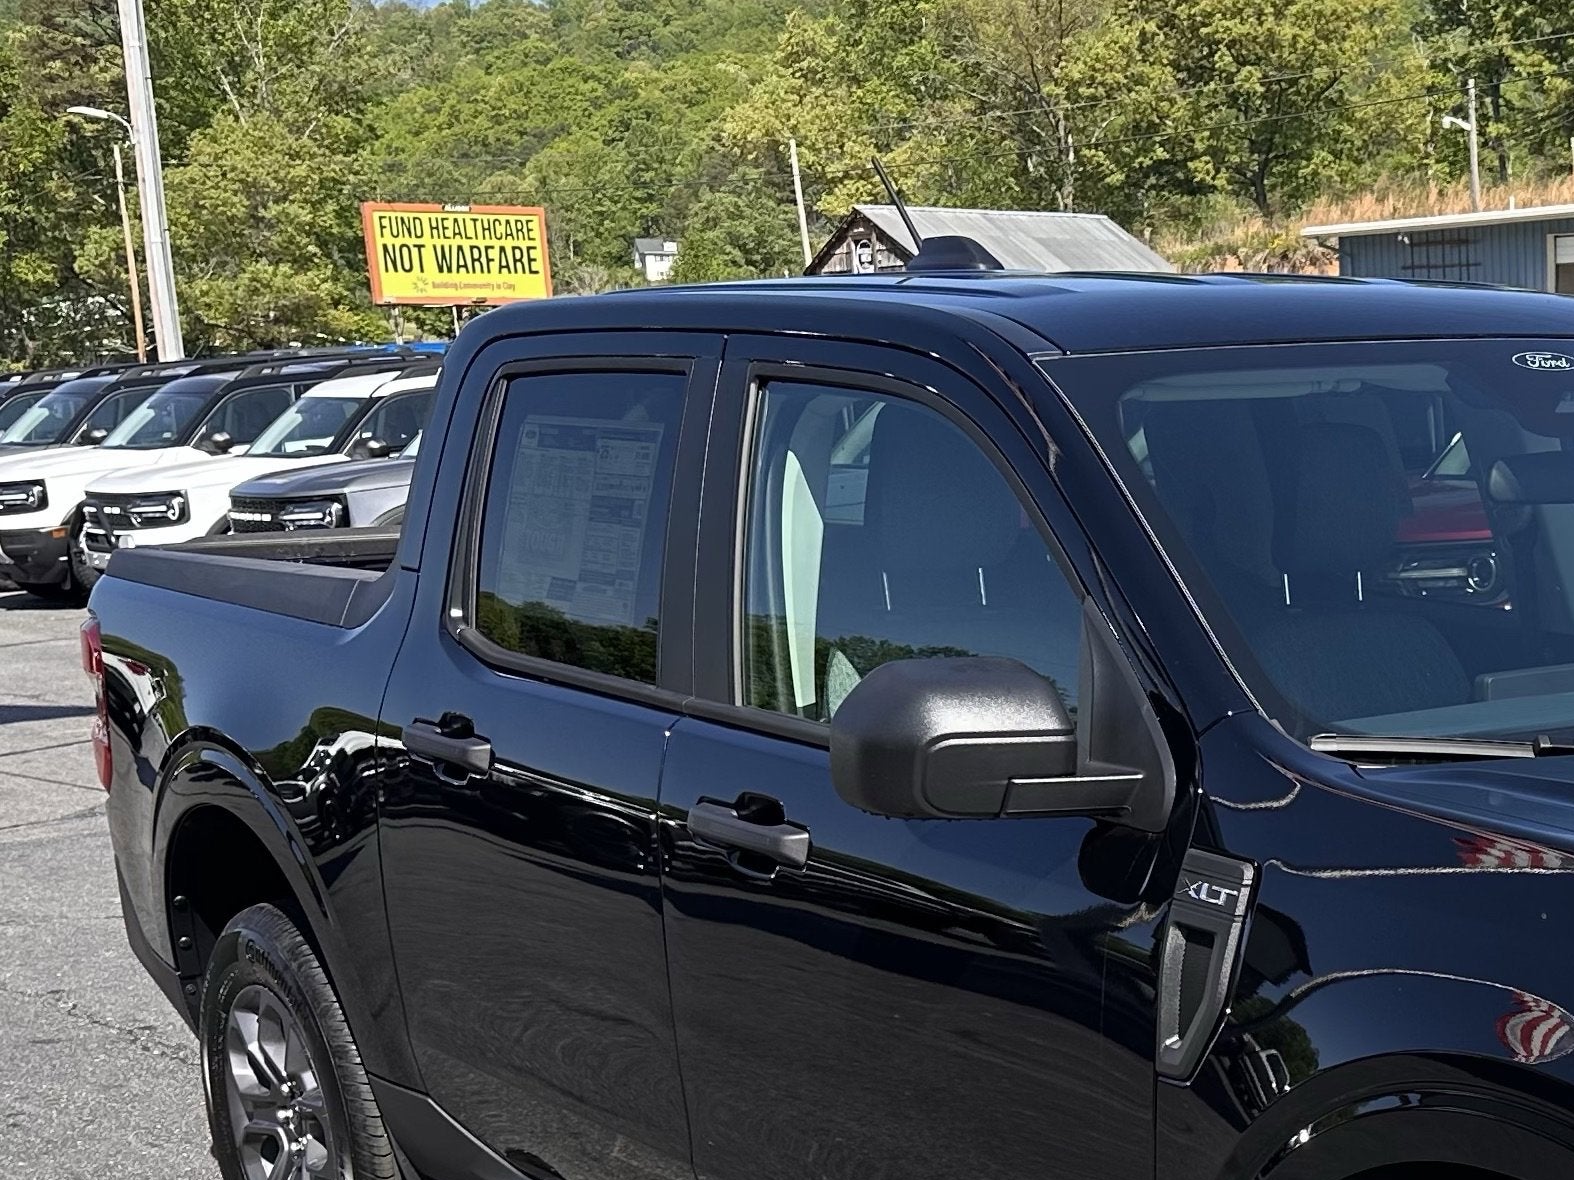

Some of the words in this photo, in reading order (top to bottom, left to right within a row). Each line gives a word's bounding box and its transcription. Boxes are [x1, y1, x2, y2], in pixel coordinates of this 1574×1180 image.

[378, 215, 424, 239] FUND
[428, 217, 537, 241] HEALTHCARE
[381, 243, 426, 273] NOT
[432, 244, 540, 275] WARFARE
[1526, 354, 1570, 368] Ford
[1177, 878, 1239, 906] XLT
